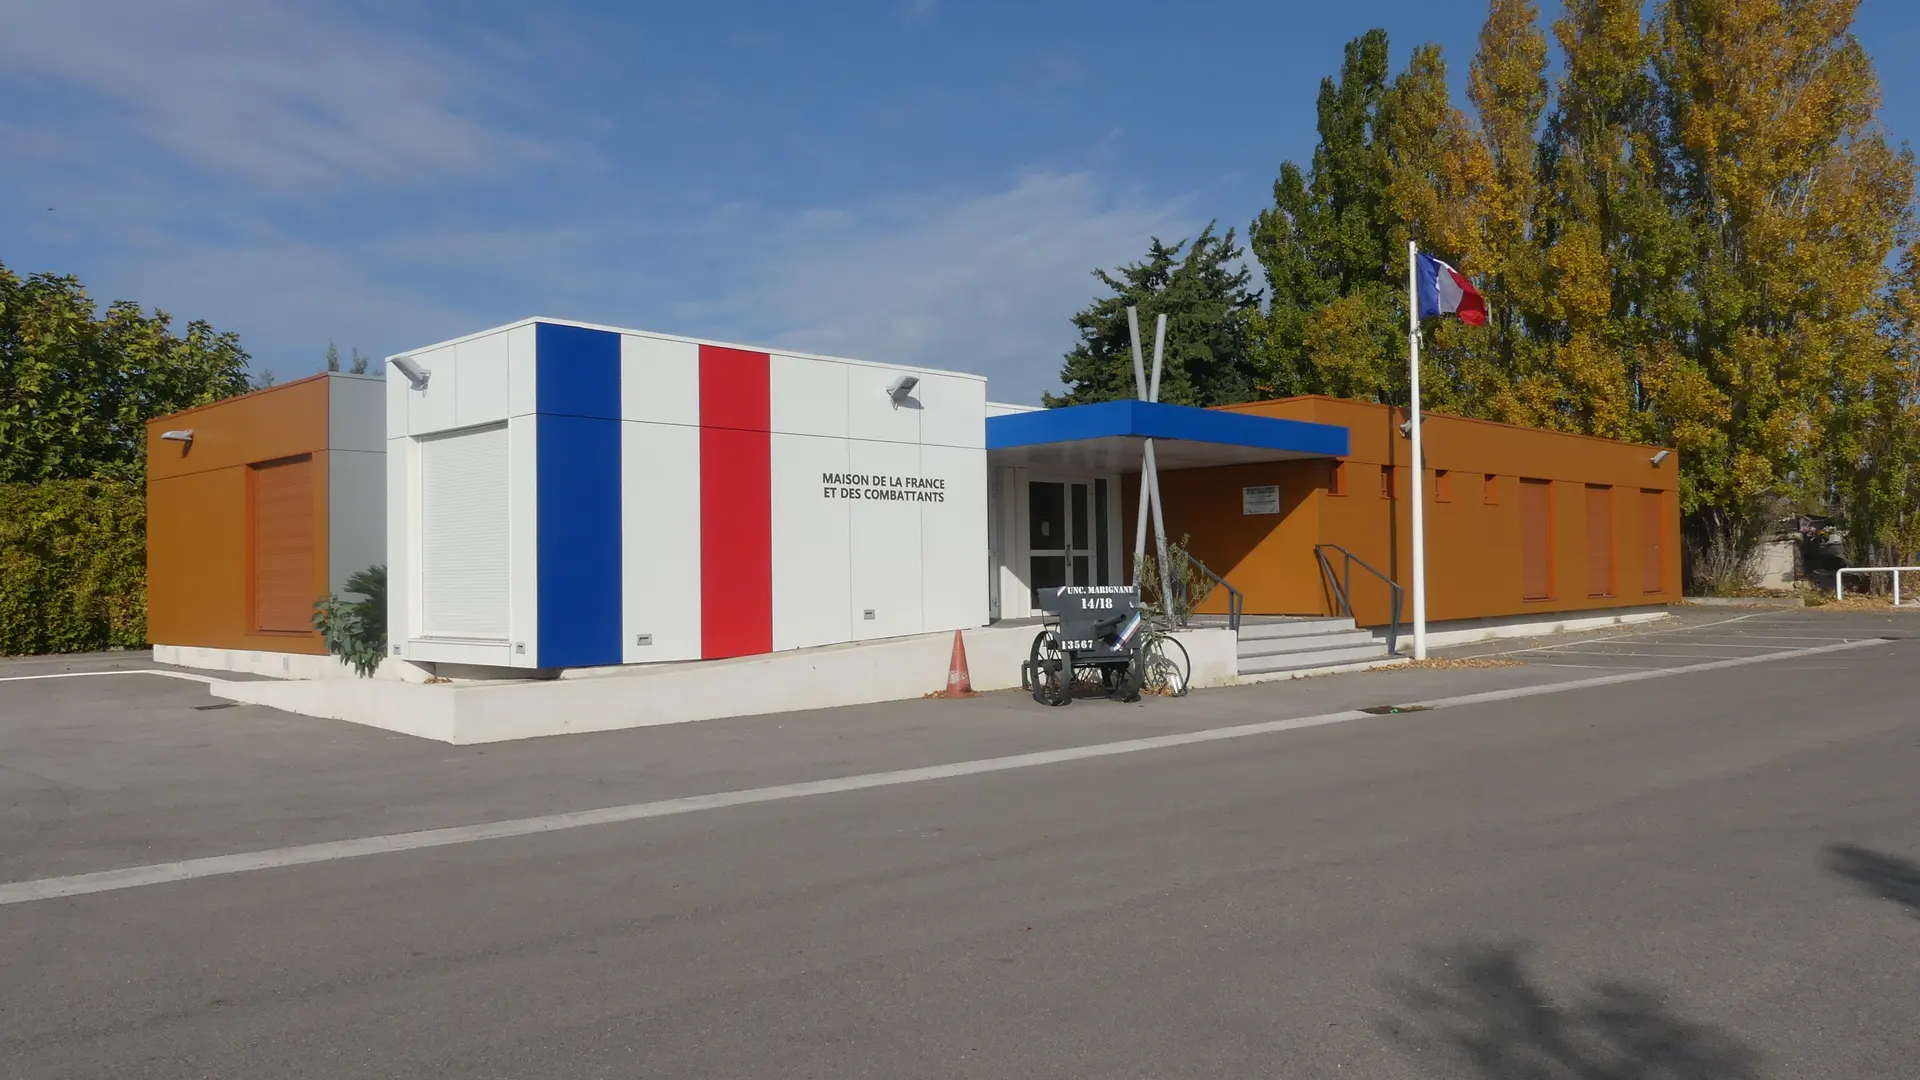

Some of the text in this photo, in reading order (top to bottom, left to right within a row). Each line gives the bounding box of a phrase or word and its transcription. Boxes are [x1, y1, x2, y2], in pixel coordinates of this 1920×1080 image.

[822, 473, 945, 489] MAISON DE LA FRANCE
[823, 487, 944, 502] ET DES COMBATTANTS
[1088, 586, 1134, 594] MARIGNANE
[1081, 598, 1113, 609] 14/18
[1061, 640, 1093, 650] 13567
